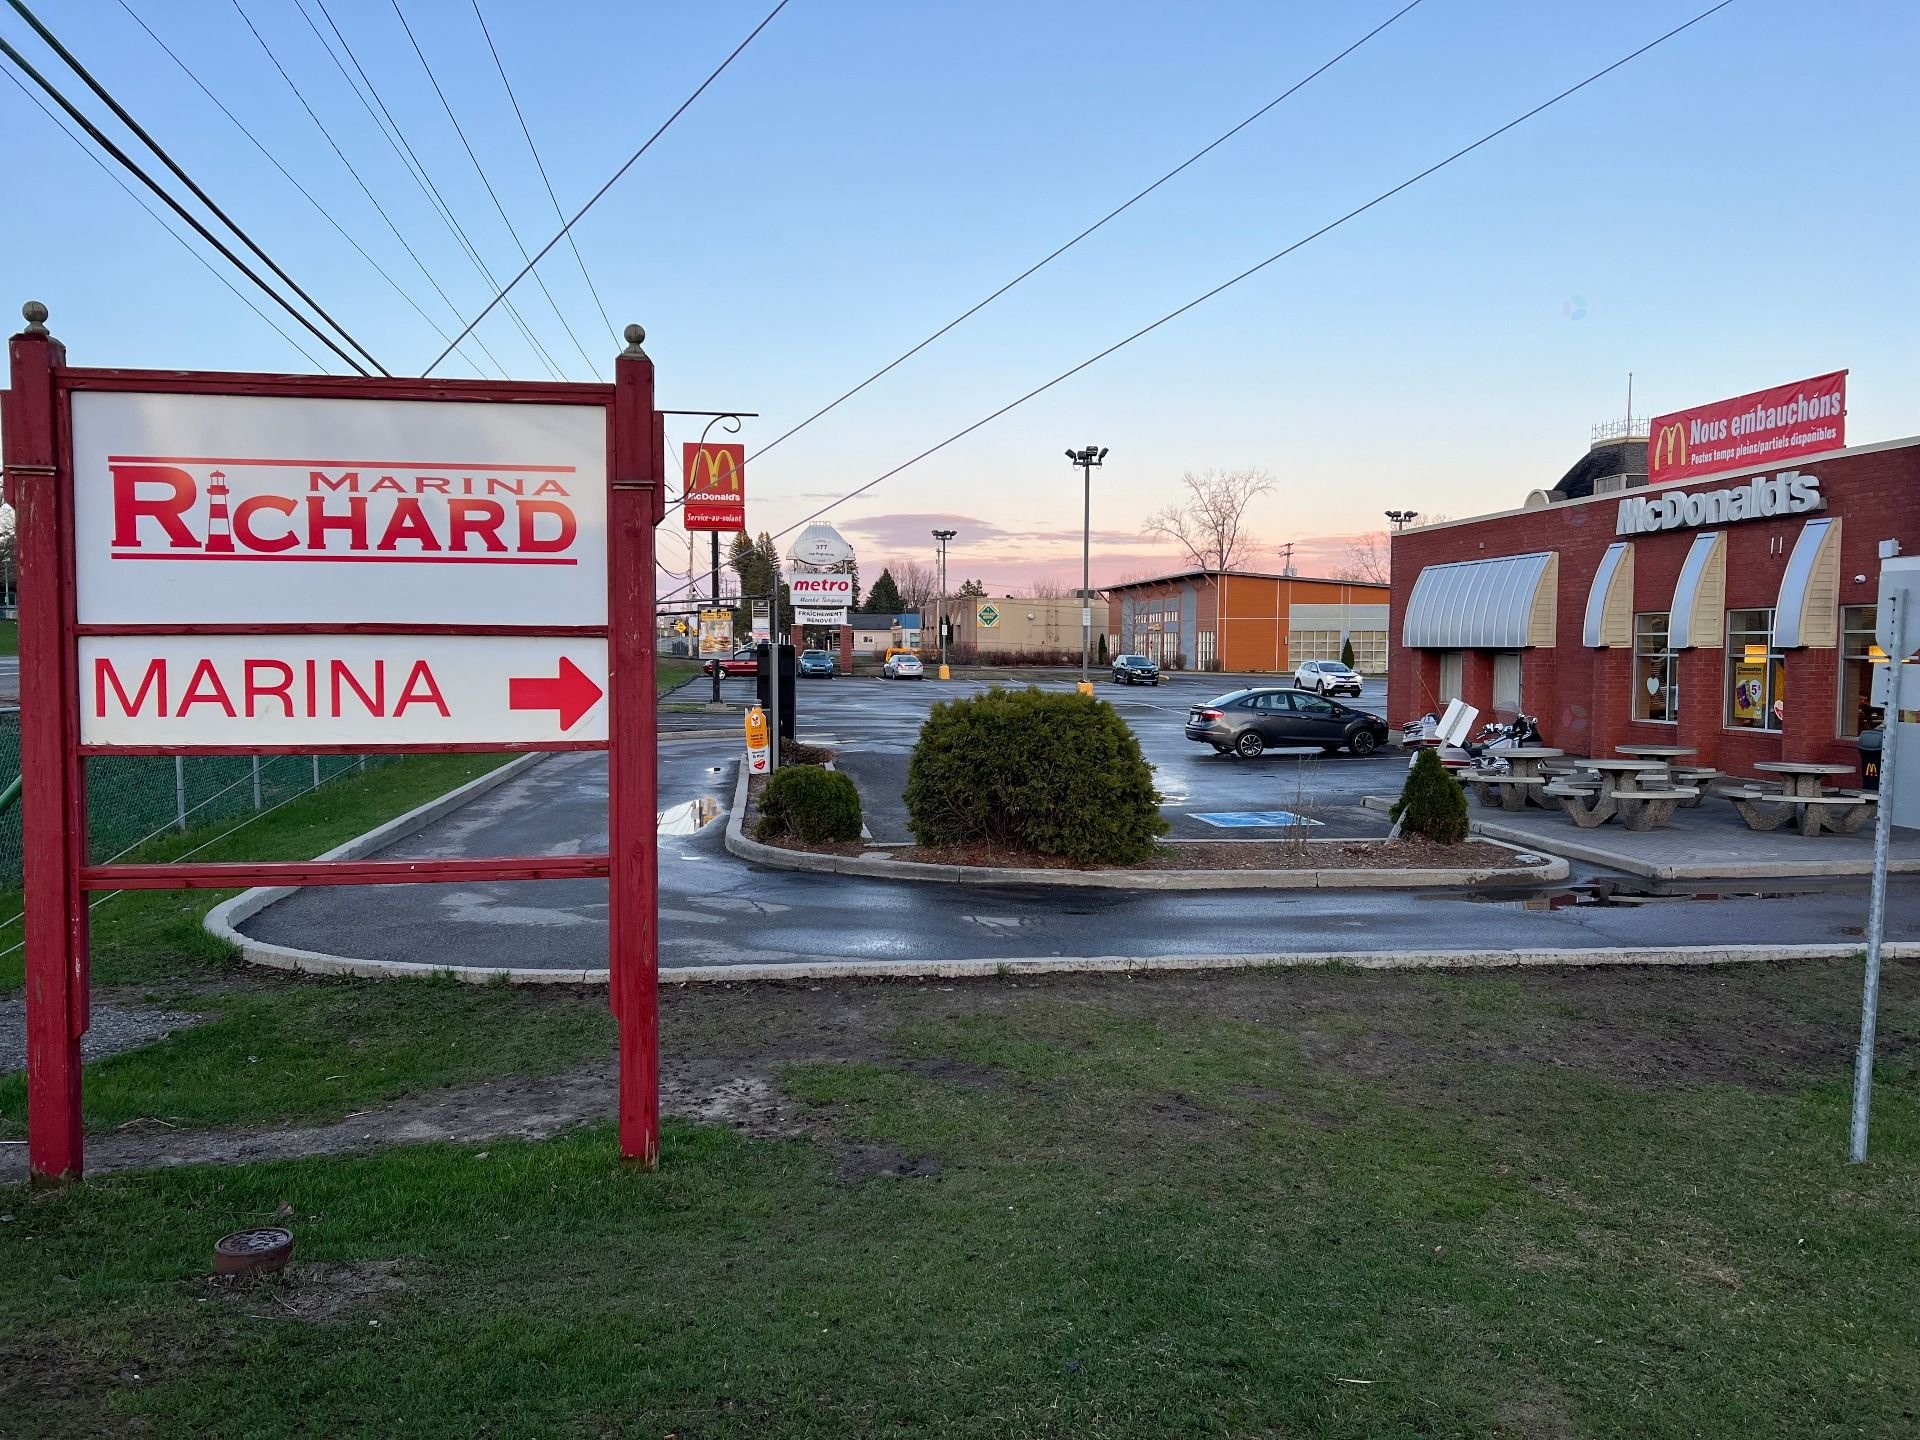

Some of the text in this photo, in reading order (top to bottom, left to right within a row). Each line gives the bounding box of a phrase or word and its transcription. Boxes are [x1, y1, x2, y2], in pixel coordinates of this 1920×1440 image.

[1689, 391, 1841, 446] Nous embauchons
[1691, 452, 1713, 465] Postes
[1713, 448, 1735, 462] temps
[1790, 427, 1837, 448] disponibles
[308, 471, 572, 497] MARINA
[687, 492, 741, 502] McDonald's
[1615, 471, 1821, 536] McDonald's
[793, 579, 849, 592] metro
[93, 657, 451, 718] MARINA
